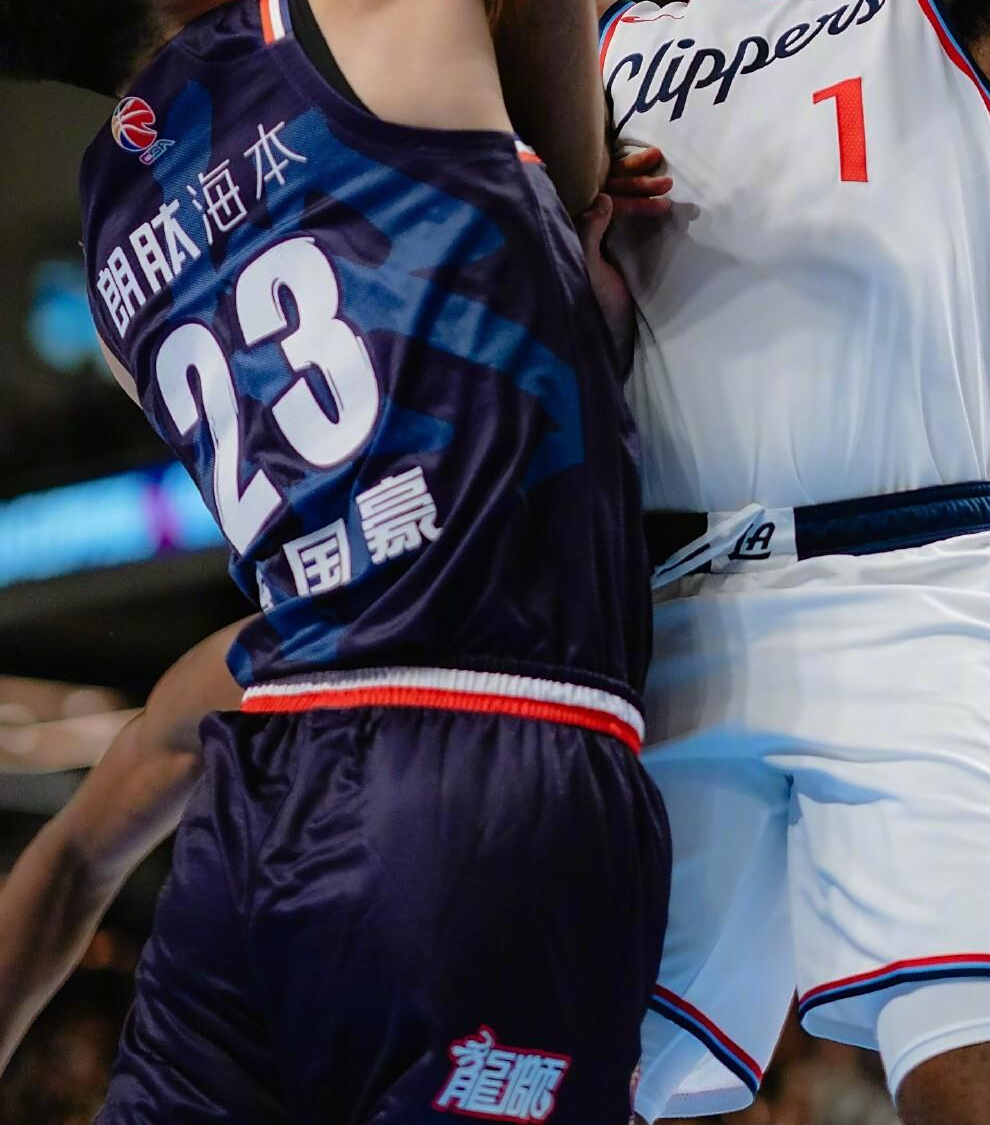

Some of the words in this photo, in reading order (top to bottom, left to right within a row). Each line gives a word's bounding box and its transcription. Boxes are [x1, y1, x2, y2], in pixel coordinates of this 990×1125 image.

[813, 77, 869, 182] 1
[154, 237, 381, 557] 23
[728, 522, 776, 560] LA
